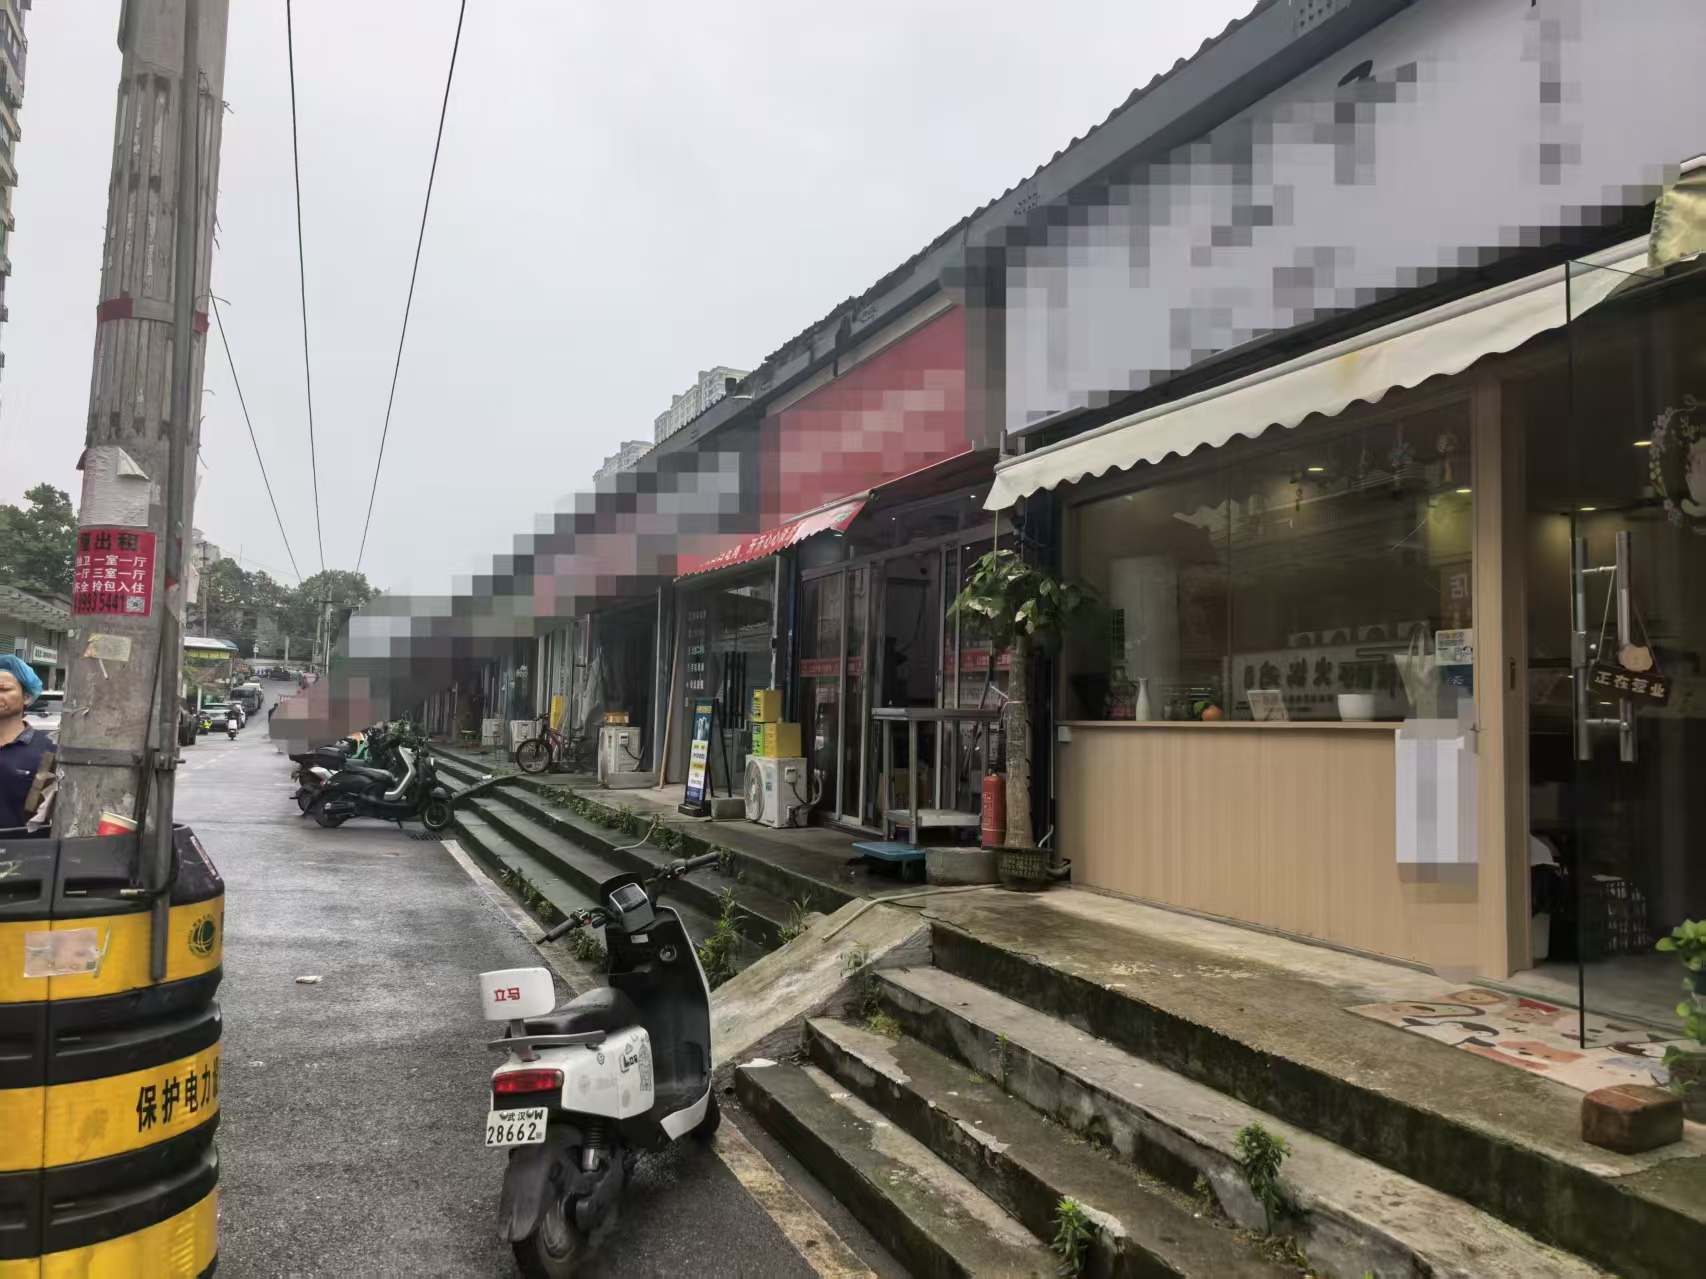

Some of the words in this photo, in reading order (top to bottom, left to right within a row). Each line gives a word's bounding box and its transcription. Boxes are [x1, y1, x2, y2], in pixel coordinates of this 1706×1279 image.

[94, 554, 147, 568] 一室一厅
[92, 567, 146, 581] 三室一厅
[92, 580, 145, 594] 拎包入住
[1594, 670, 1665, 698] 正在营业
[493, 987, 521, 1002] 立马
[487, 1122, 537, 1144] 28662
